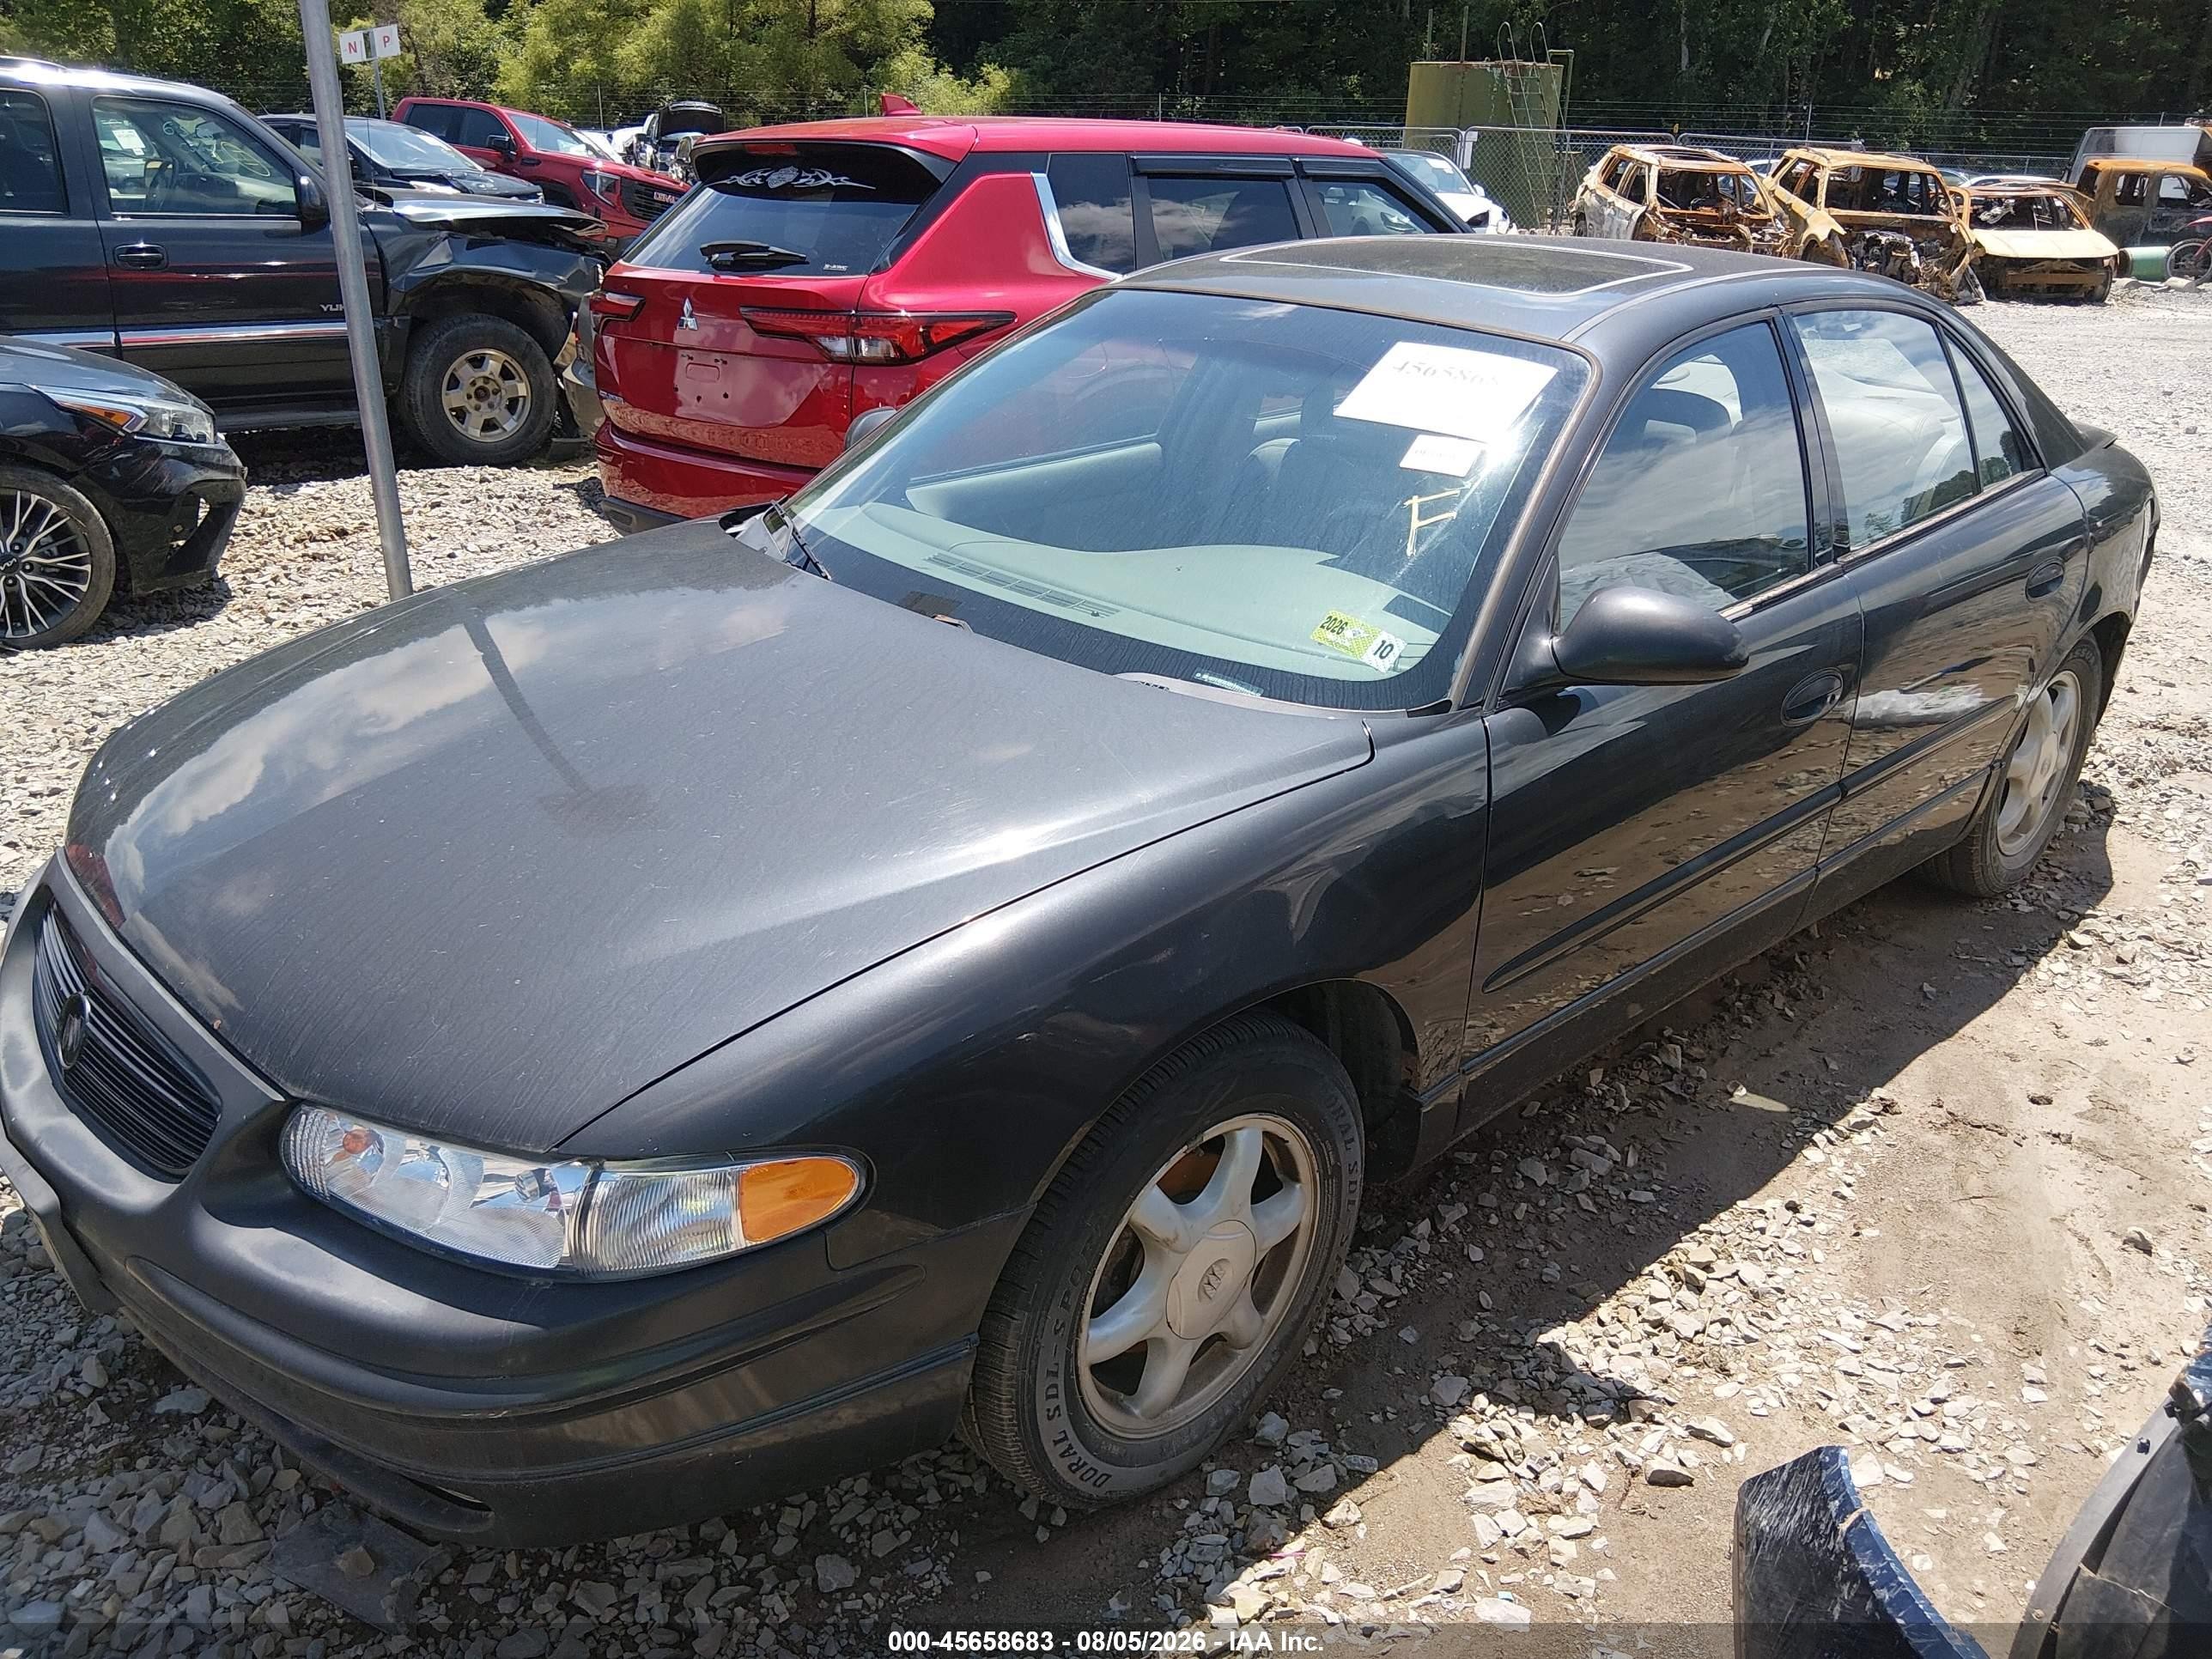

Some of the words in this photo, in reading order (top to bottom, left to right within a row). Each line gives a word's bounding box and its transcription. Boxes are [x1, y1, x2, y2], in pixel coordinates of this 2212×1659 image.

[347, 40, 358, 54] N
[382, 35, 391, 48] P
[1319, 615, 1349, 635] 2026
[1374, 640, 1395, 659] 10
[1051, 1427, 1114, 1490] DORAL
